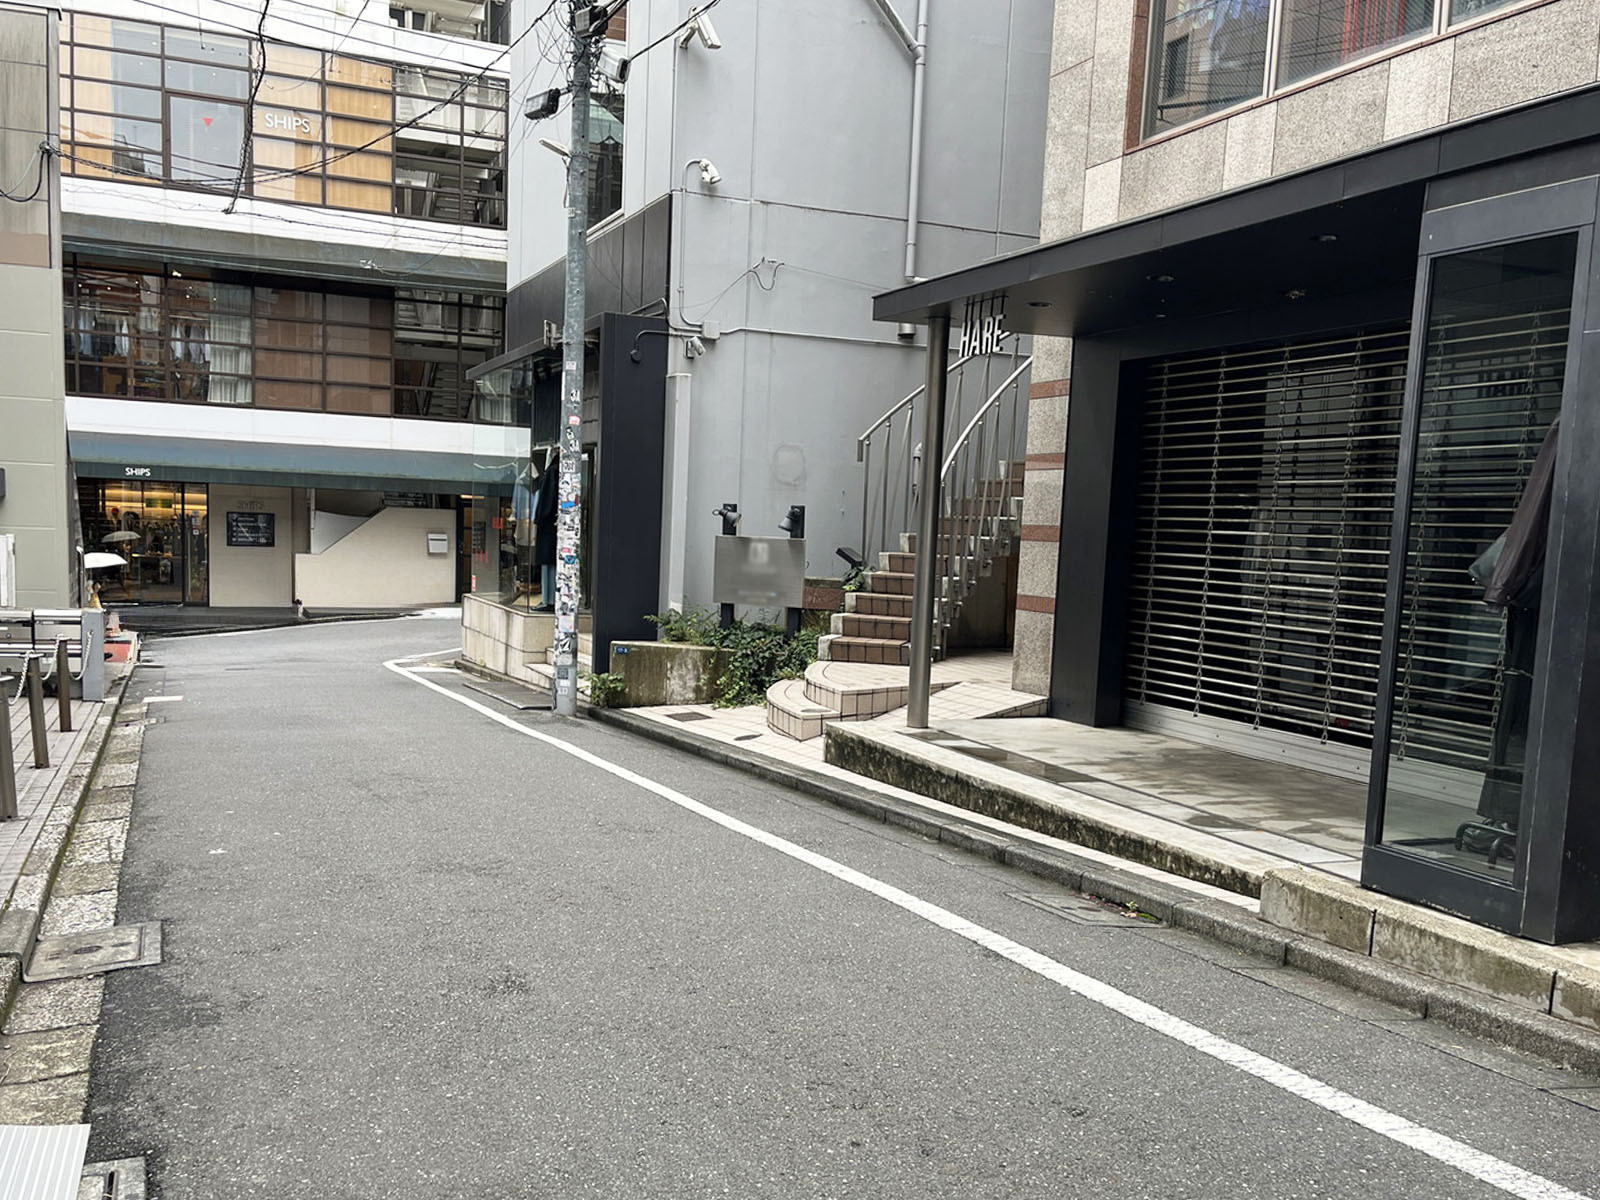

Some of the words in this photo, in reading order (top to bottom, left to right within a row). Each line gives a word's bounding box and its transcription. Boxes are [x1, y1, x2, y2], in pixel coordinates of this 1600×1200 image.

[265, 113, 310, 133] SHIPS
[958, 314, 1005, 358] HARE
[124, 466, 151, 477] SHIPS
